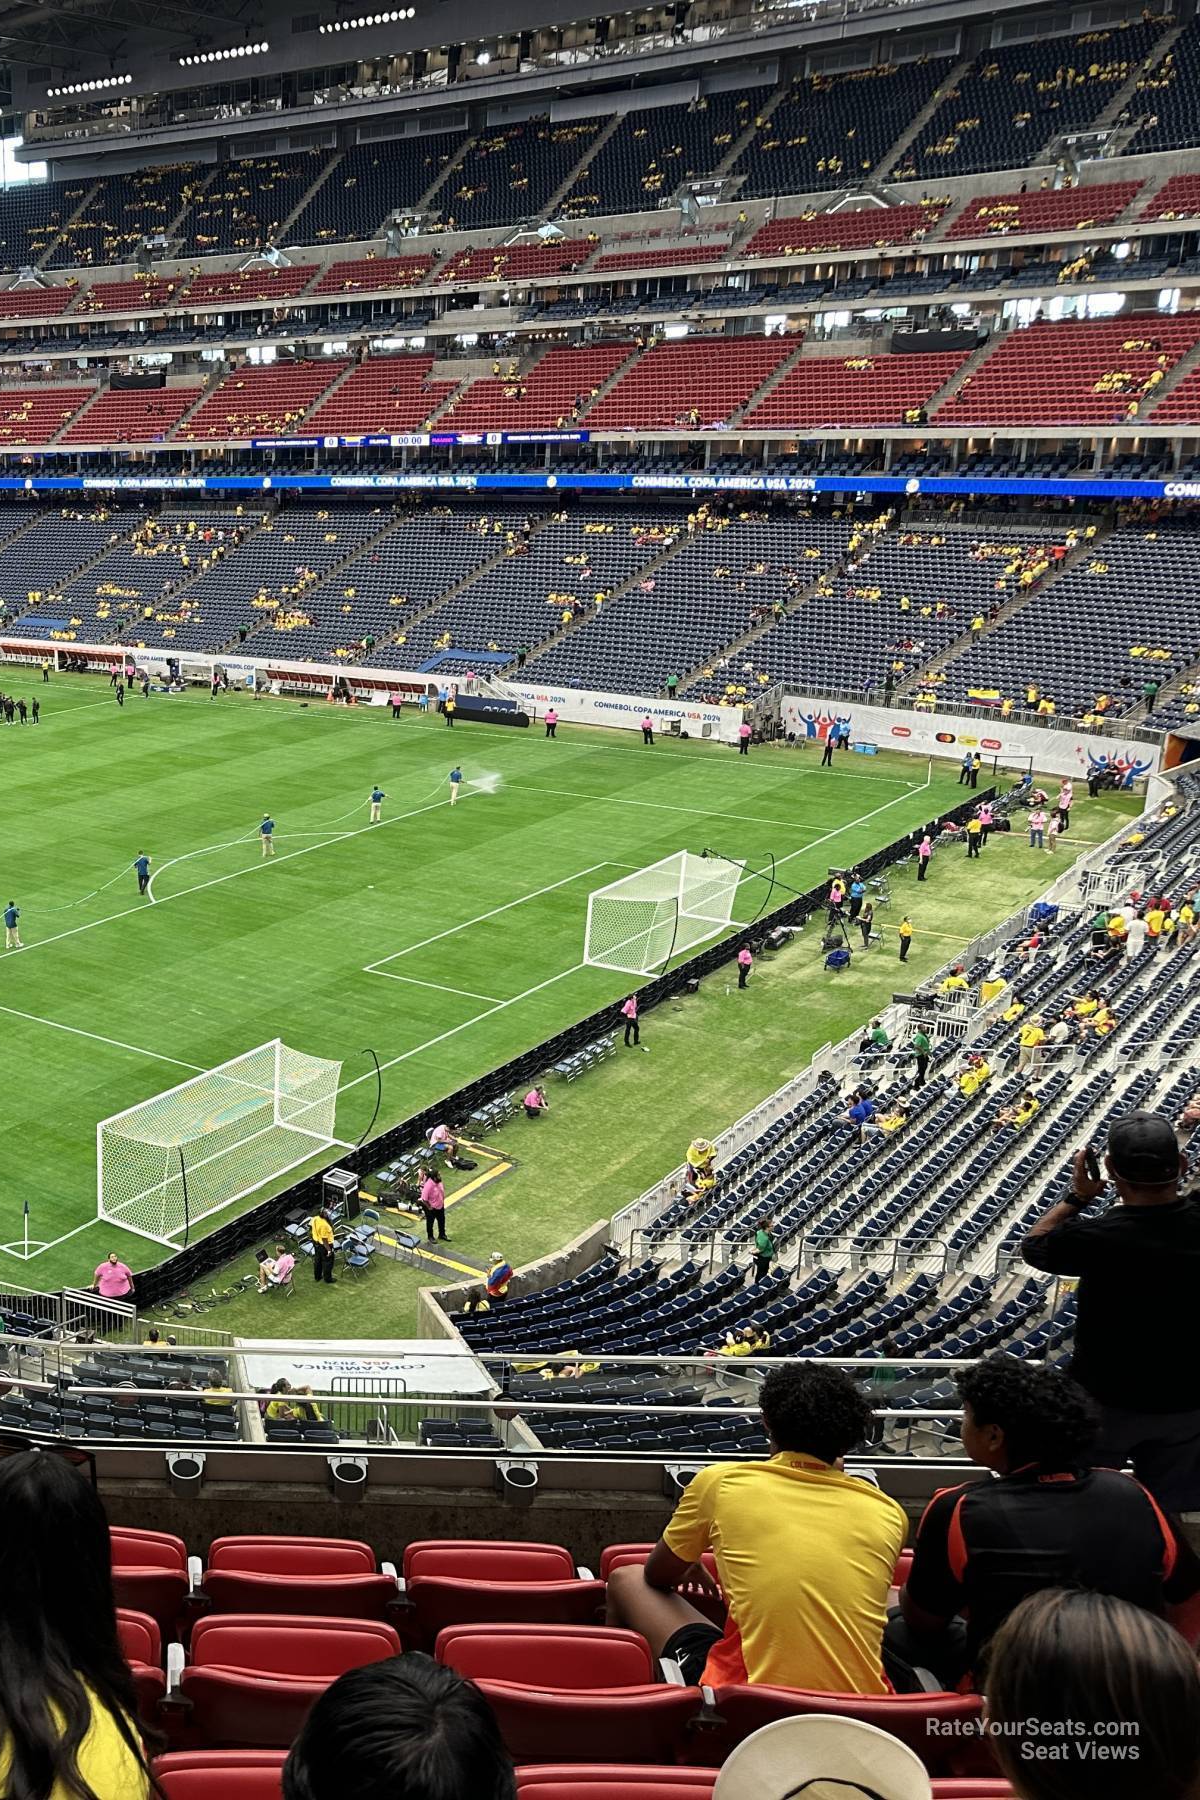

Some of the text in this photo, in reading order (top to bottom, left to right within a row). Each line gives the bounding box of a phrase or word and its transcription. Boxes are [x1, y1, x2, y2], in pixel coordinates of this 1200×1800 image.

[632, 476, 816, 490] CONMEBOL COPA AMERICA USA 2024
[536, 694, 549, 702] USA
[550, 696, 566, 704] 2024
[594, 700, 720, 721] CONMEBOL COPA AMERICA USA 2024
[292, 1363, 425, 1371] COPA AMERICA
